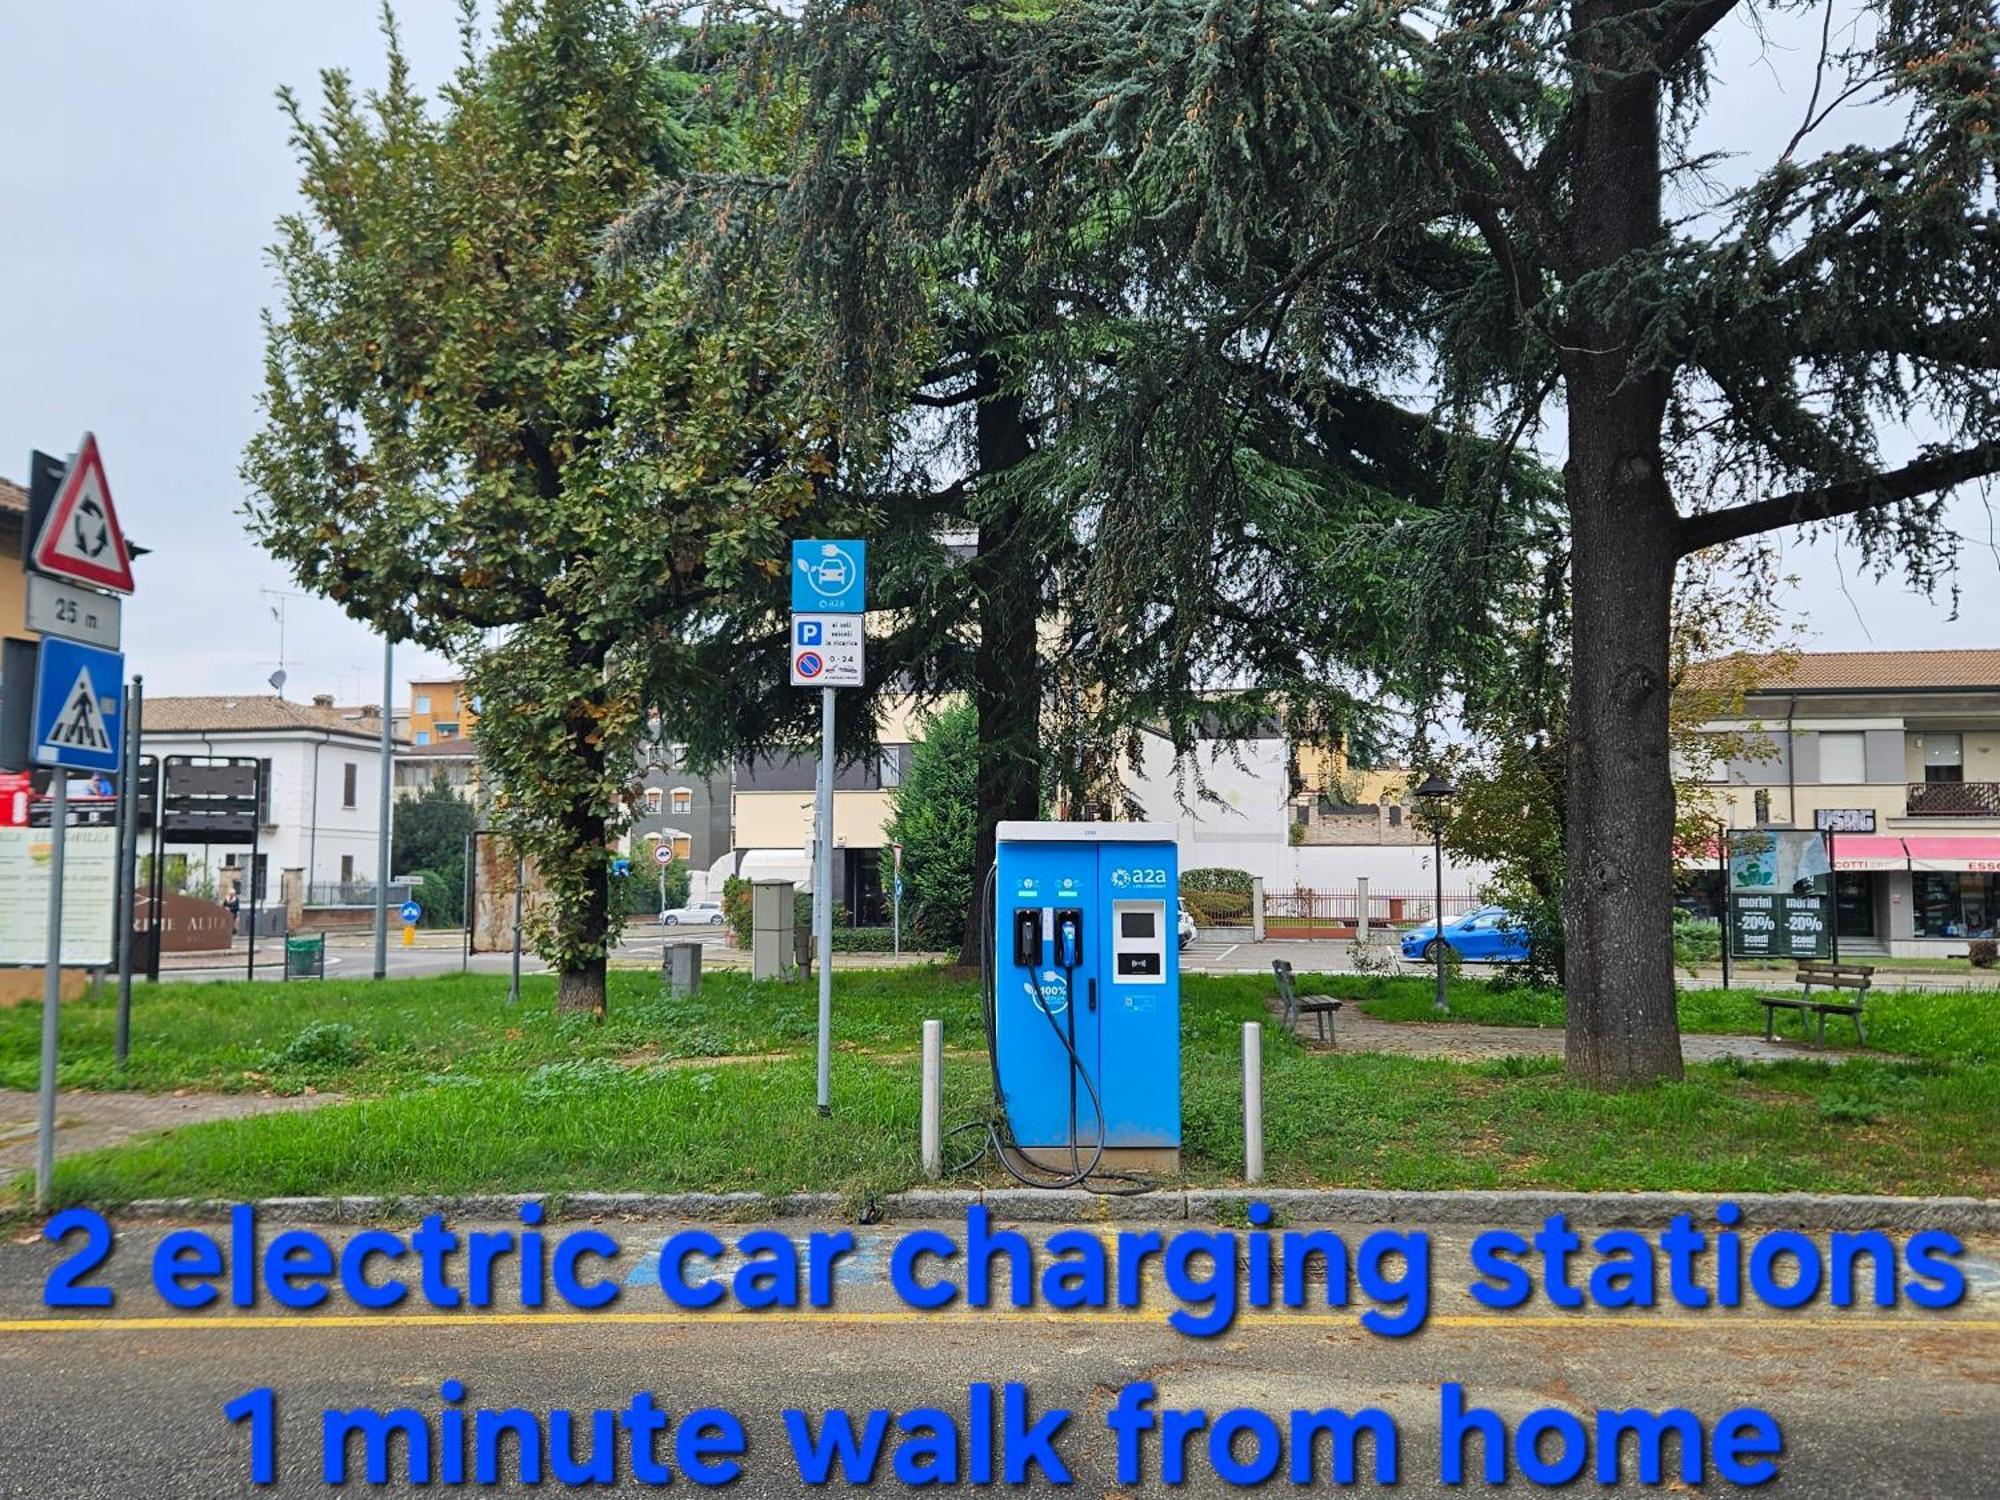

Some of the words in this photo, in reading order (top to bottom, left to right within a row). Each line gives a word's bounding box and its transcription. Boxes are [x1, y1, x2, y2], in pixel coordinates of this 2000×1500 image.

[55, 598, 78, 624] 25
[84, 613, 98, 629] m
[803, 624, 818, 643] P
[1132, 868, 1167, 884] a2a
[1738, 895, 1773, 909] morini
[1785, 896, 1820, 909] morini
[1737, 915, 1775, 930] -20%
[1784, 916, 1823, 931] -20%
[1040, 985, 1067, 996] 100%
